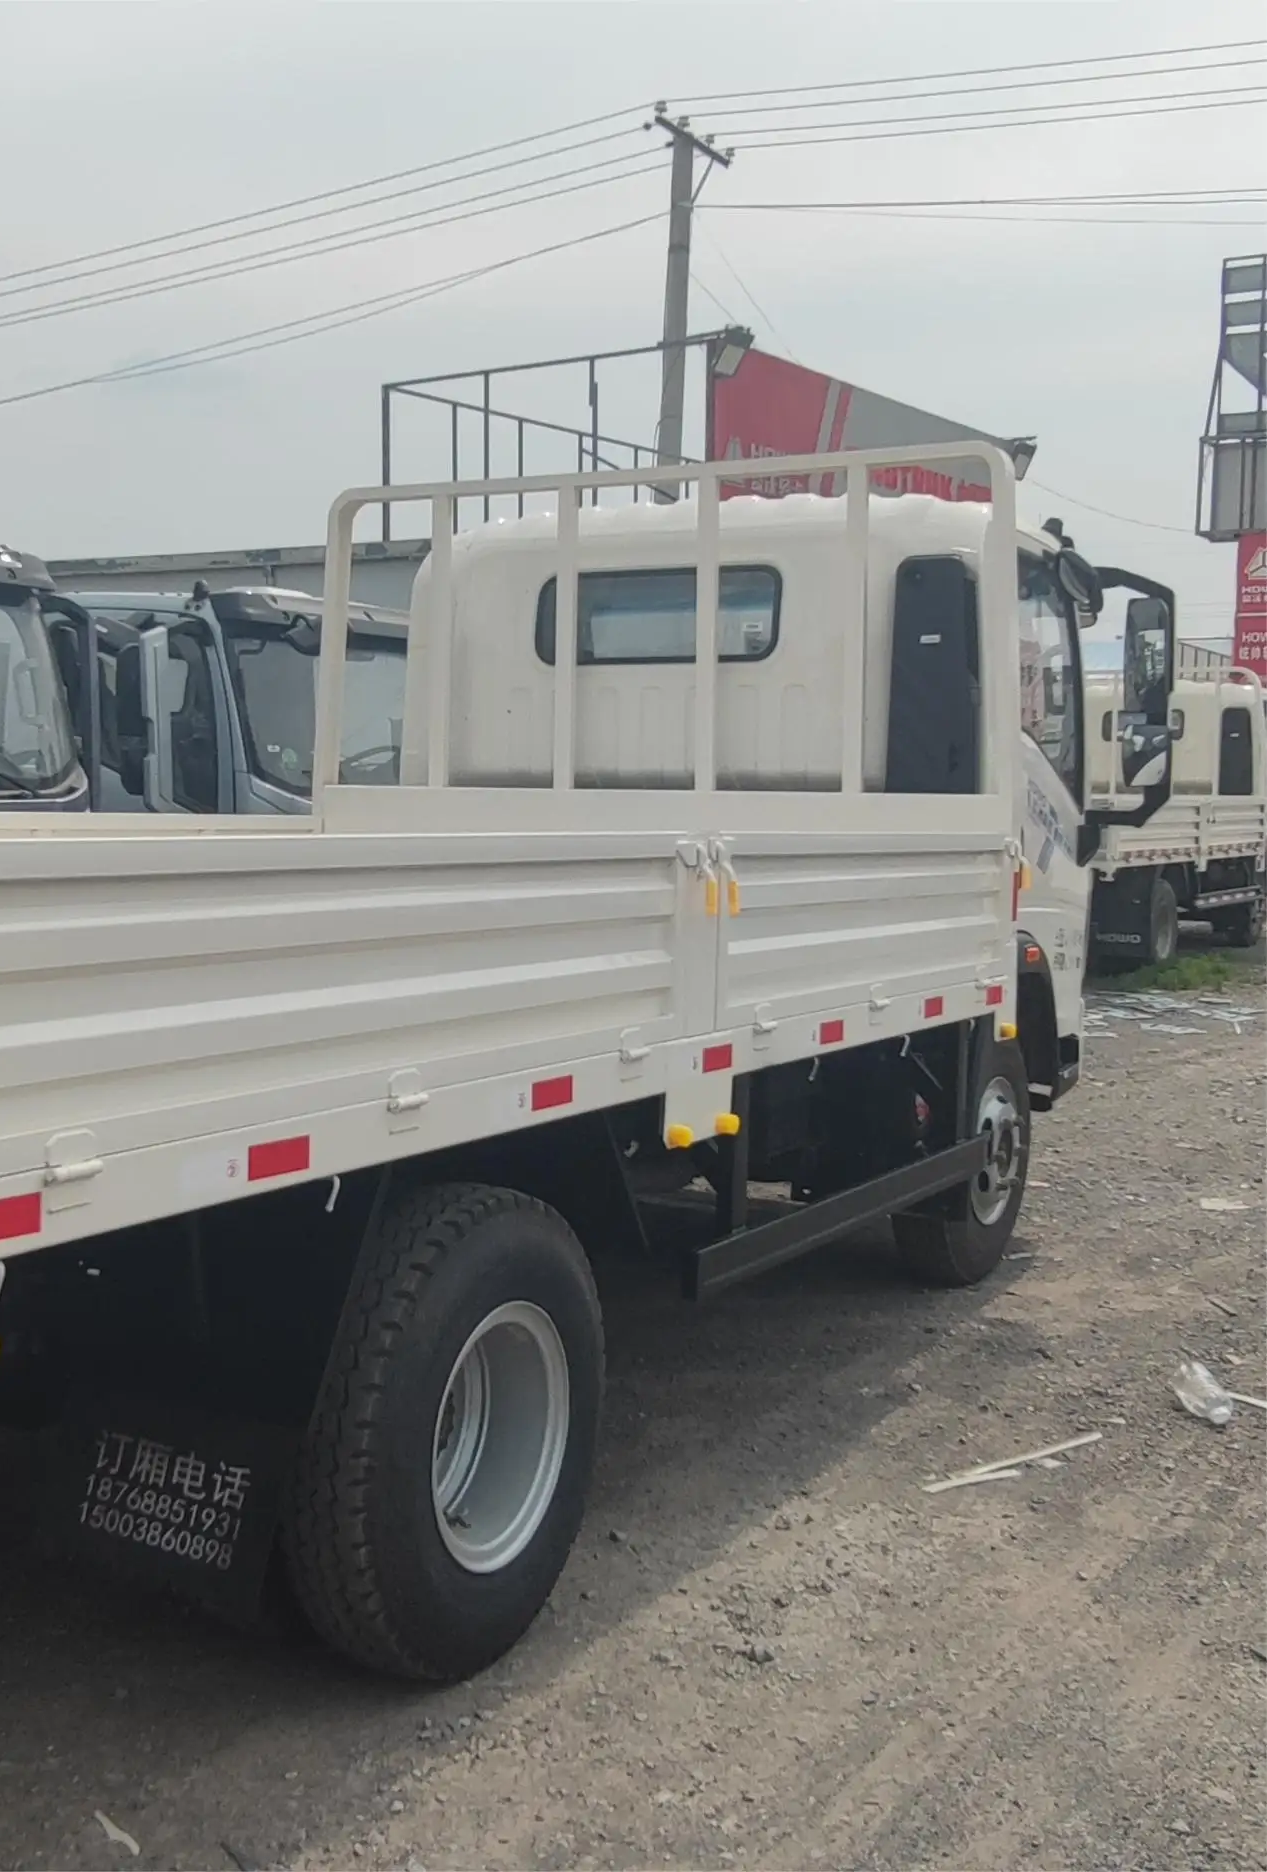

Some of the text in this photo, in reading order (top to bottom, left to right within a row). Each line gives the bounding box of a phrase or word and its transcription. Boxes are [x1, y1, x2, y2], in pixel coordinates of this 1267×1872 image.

[95, 1430, 251, 1510] 订厢电话
[78, 1501, 233, 1570] 15003860898
[86, 1473, 241, 1541] 18768851931
